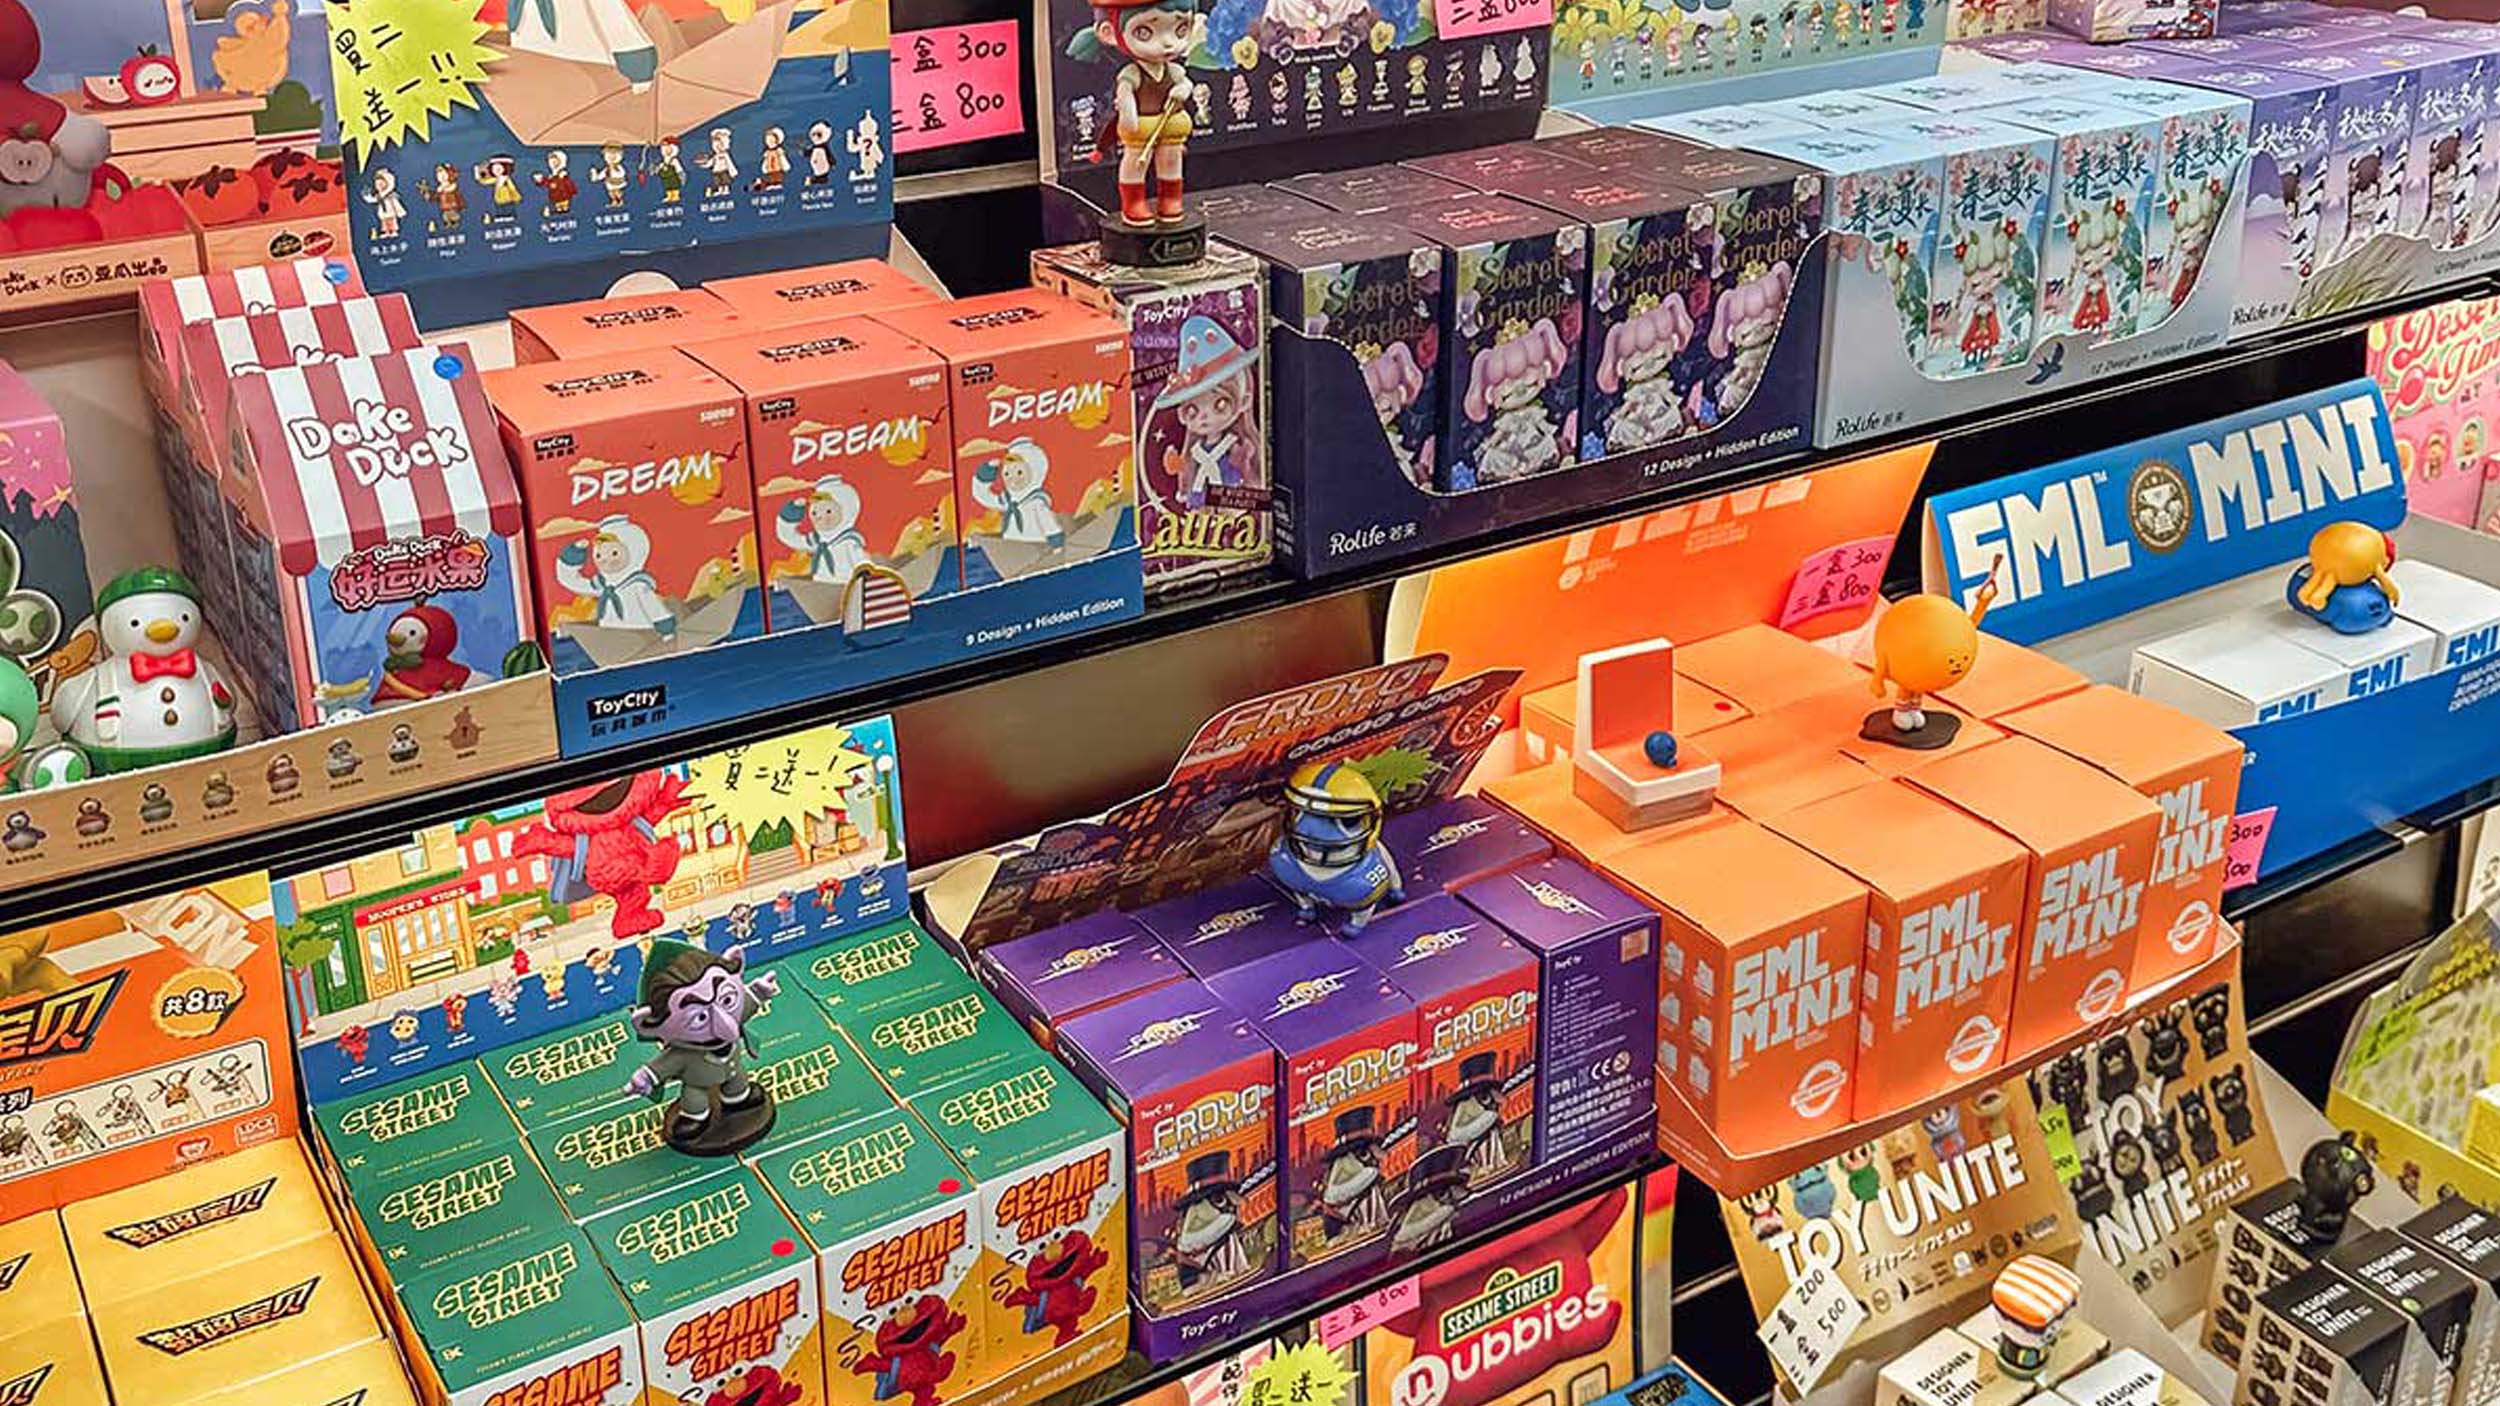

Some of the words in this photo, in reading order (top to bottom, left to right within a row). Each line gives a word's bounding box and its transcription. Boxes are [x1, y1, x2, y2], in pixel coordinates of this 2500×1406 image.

[957, 33, 1007, 62] 300
[956, 83, 1005, 119] 800
[1717, 201, 1800, 240] Secret
[1472, 252, 1565, 298] Secret
[1614, 229, 1693, 270] Secret
[1327, 277, 1417, 314] Secret
[988, 381, 1102, 428] DREAM
[791, 415, 918, 466] DREAM
[1660, 452, 1703, 478] Design
[1714, 438, 1758, 459] Hidden
[1759, 425, 1800, 448] Edition
[571, 451, 712, 505] DREAM
[1947, 472, 2133, 612] SML
[2188, 393, 2396, 544] MINI
[1328, 529, 1386, 555] Rolife
[1850, 548, 1882, 569] 300
[1839, 573, 1871, 601] 800
[977, 625, 1022, 647] Design
[1035, 610, 1080, 629] Hidden
[1081, 597, 1126, 618] Edition
[2156, 780, 2210, 840] ML
[2150, 816, 2230, 888] INI
[2040, 847, 2125, 918] SML
[1899, 890, 1988, 967] SML
[2029, 882, 2145, 974] MINI
[812, 930, 921, 981] SESAME
[840, 951, 915, 985] STREET
[1731, 928, 1830, 1010] SML
[1893, 923, 2013, 1022] MINI
[872, 993, 985, 1047] SESAME
[903, 1018, 979, 1055] STREET
[1434, 990, 1528, 1049] FROYO
[1728, 963, 1856, 1067] MINI
[505, 1022, 629, 1079] SESAME
[535, 1045, 618, 1085] STREET
[747, 1045, 840, 1092] SAME
[1306, 1042, 1406, 1106] FROYO
[340, 1075, 471, 1134] SESAME
[939, 1065, 1058, 1125] SESAME
[973, 1094, 1051, 1135] STREET
[1153, 1084, 1262, 1150] FROYO
[370, 1103, 458, 1143] STREET
[554, 1103, 668, 1162] SESAM
[585, 1131, 666, 1170] STREE
[790, 1123, 916, 1187] SESAME
[823, 1150, 907, 1197] STREET
[379, 1155, 518, 1221] SESAME
[412, 1189, 504, 1231] STREET
[995, 1148, 1112, 1230] SESAME
[1768, 1200, 1870, 1290] TOY
[1878, 1132, 2028, 1237] UNITE
[615, 1184, 751, 1256] SESAME
[650, 1213, 739, 1265] STREET
[1016, 1195, 1090, 1246] STREET
[841, 1210, 968, 1294] SESAME
[433, 1242, 578, 1319] SESAME
[468, 1278, 564, 1330] STREET
[867, 1259, 950, 1310] STREET
[1446, 1294, 1502, 1338] SESAME
[1503, 1269, 1557, 1311] STREET
[1796, 1268, 1825, 1306] 200
[664, 1278, 801, 1367] SESAME
[1817, 1297, 1847, 1339] 500
[691, 1321, 781, 1383] STREET
[1915, 1351, 1976, 1392] DESIGNER
[1930, 1379, 1956, 1398] TOY
